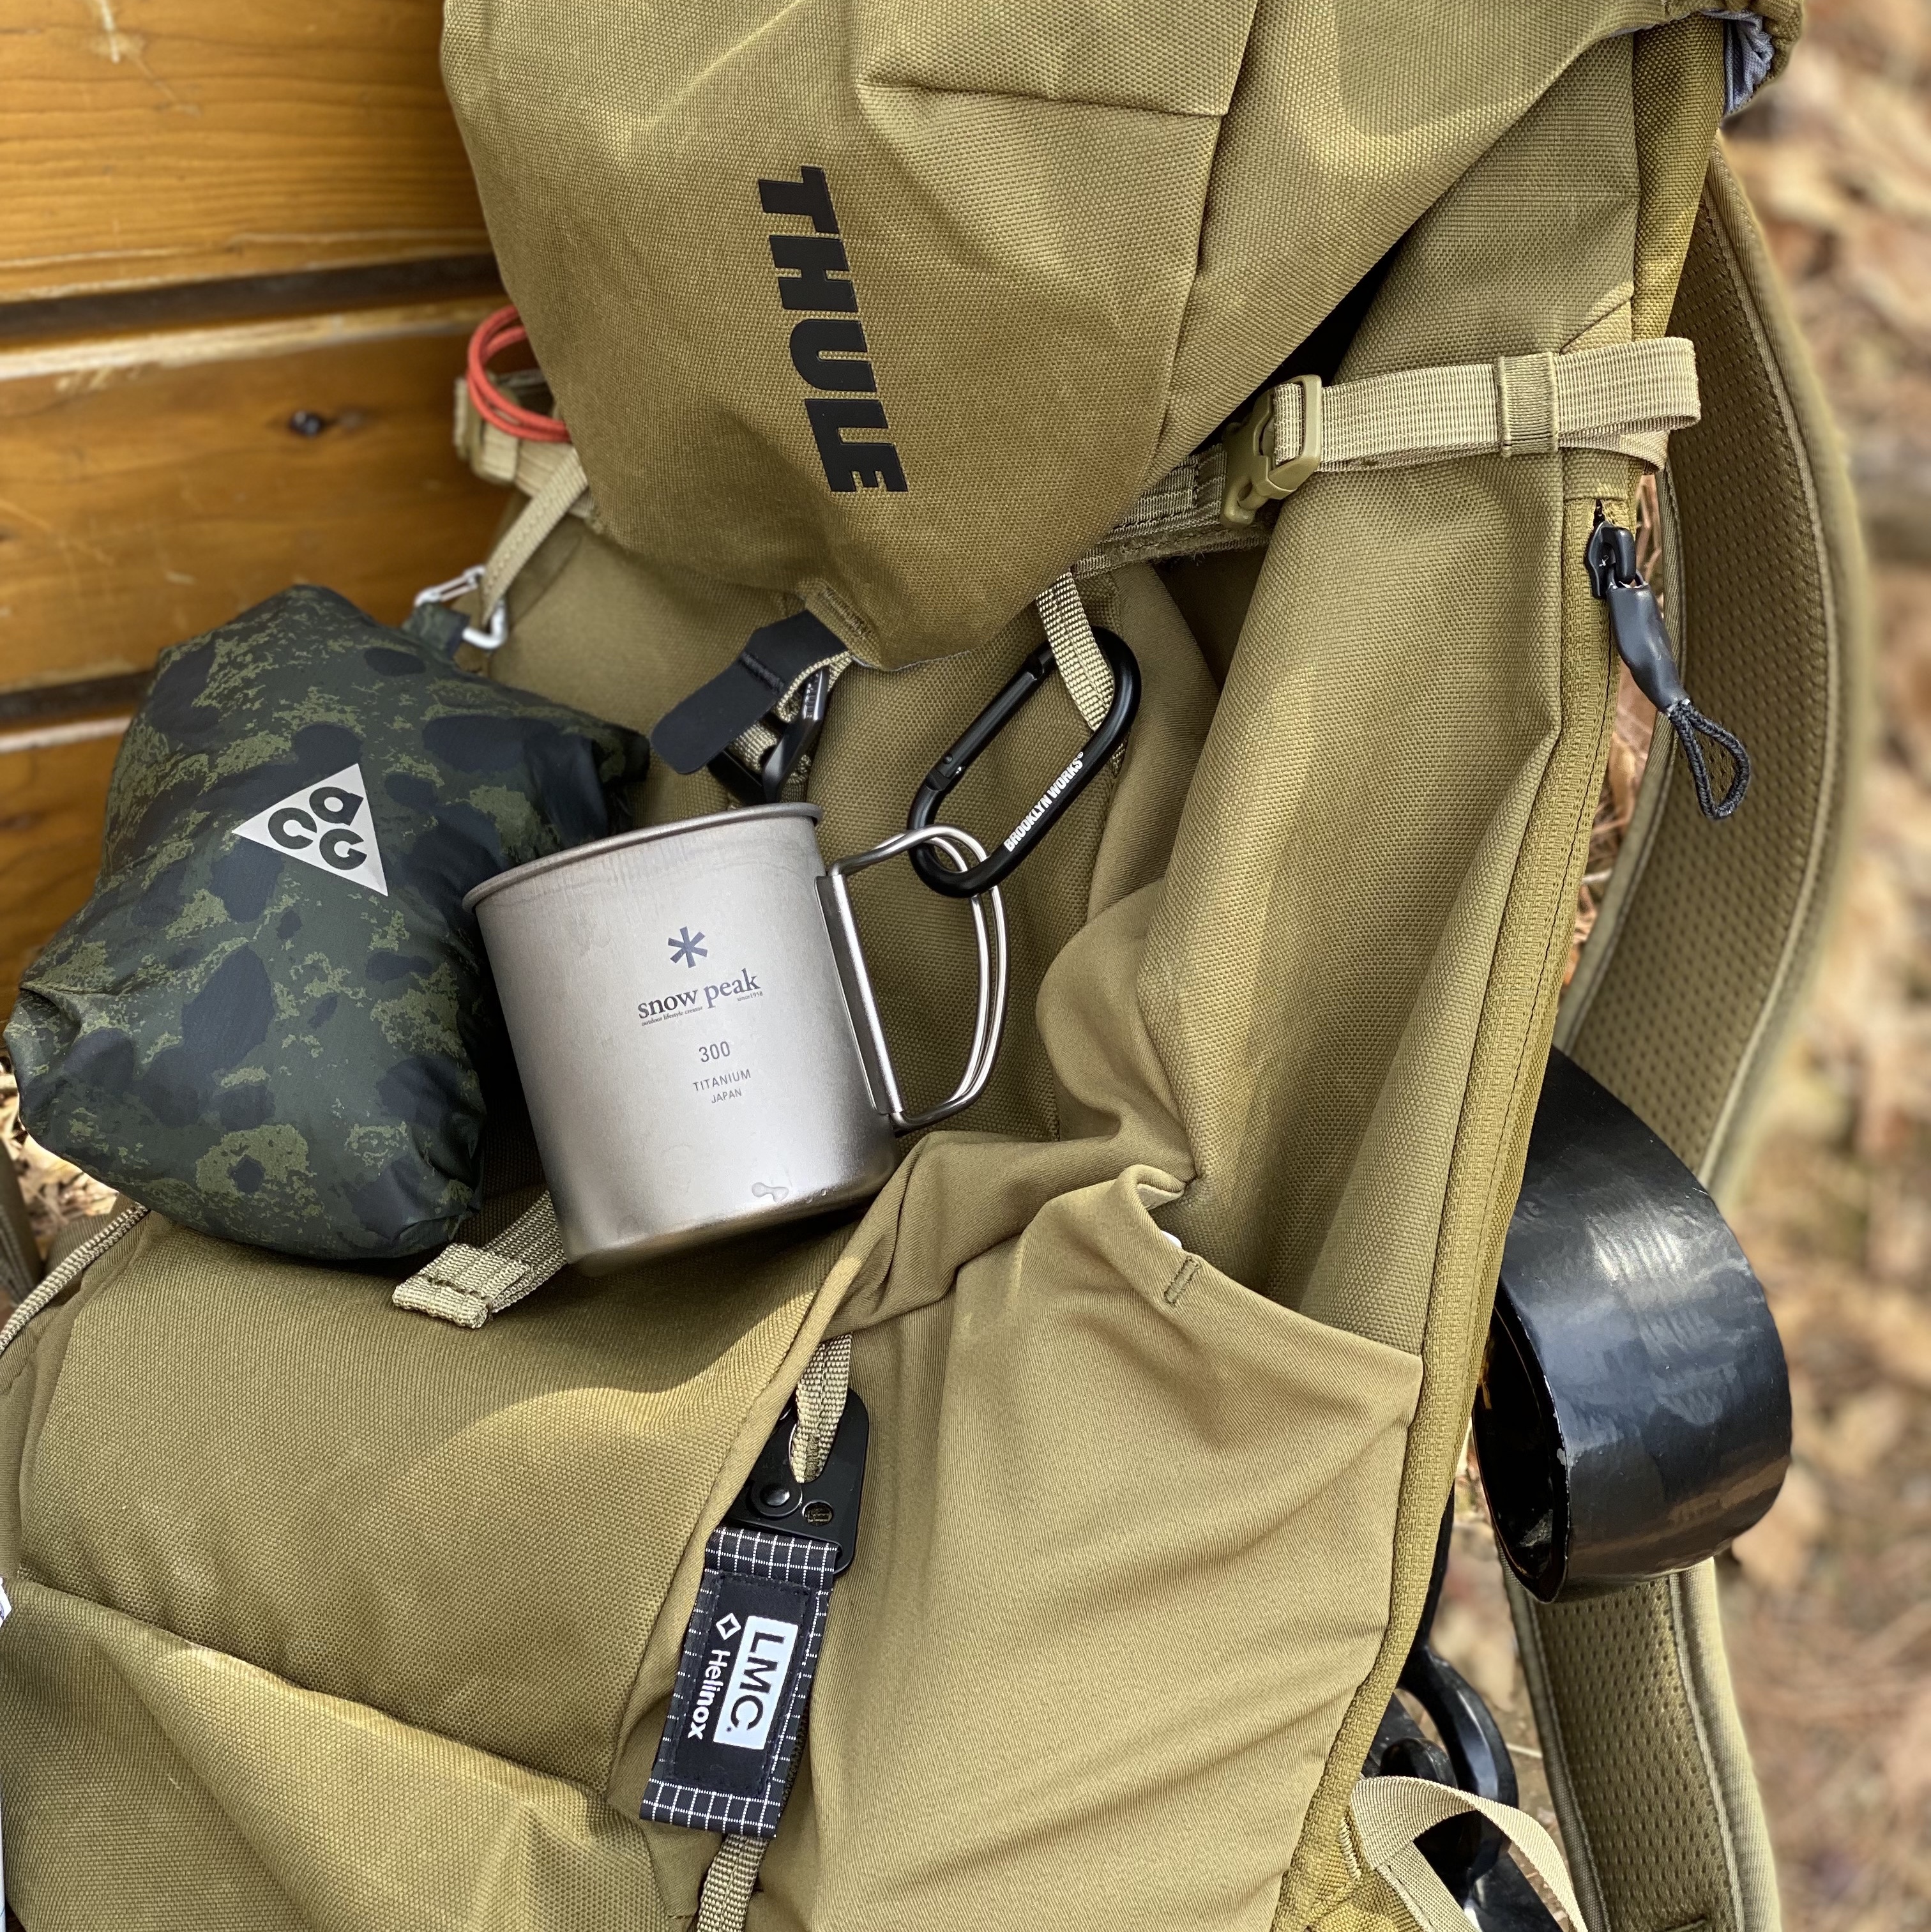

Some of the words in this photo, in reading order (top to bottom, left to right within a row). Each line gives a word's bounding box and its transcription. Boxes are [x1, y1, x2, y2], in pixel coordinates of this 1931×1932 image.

[758, 166, 908, 491] THULE
[1003, 794, 1052, 852] BROOKLYN
[638, 989, 698, 1019] snow
[704, 968, 761, 1008] peak
[699, 1041, 731, 1062] 300
[692, 1069, 751, 1092] TITANIUM
[711, 1088, 742, 1104] JAPAN
[688, 1650, 731, 1740] Helinox
